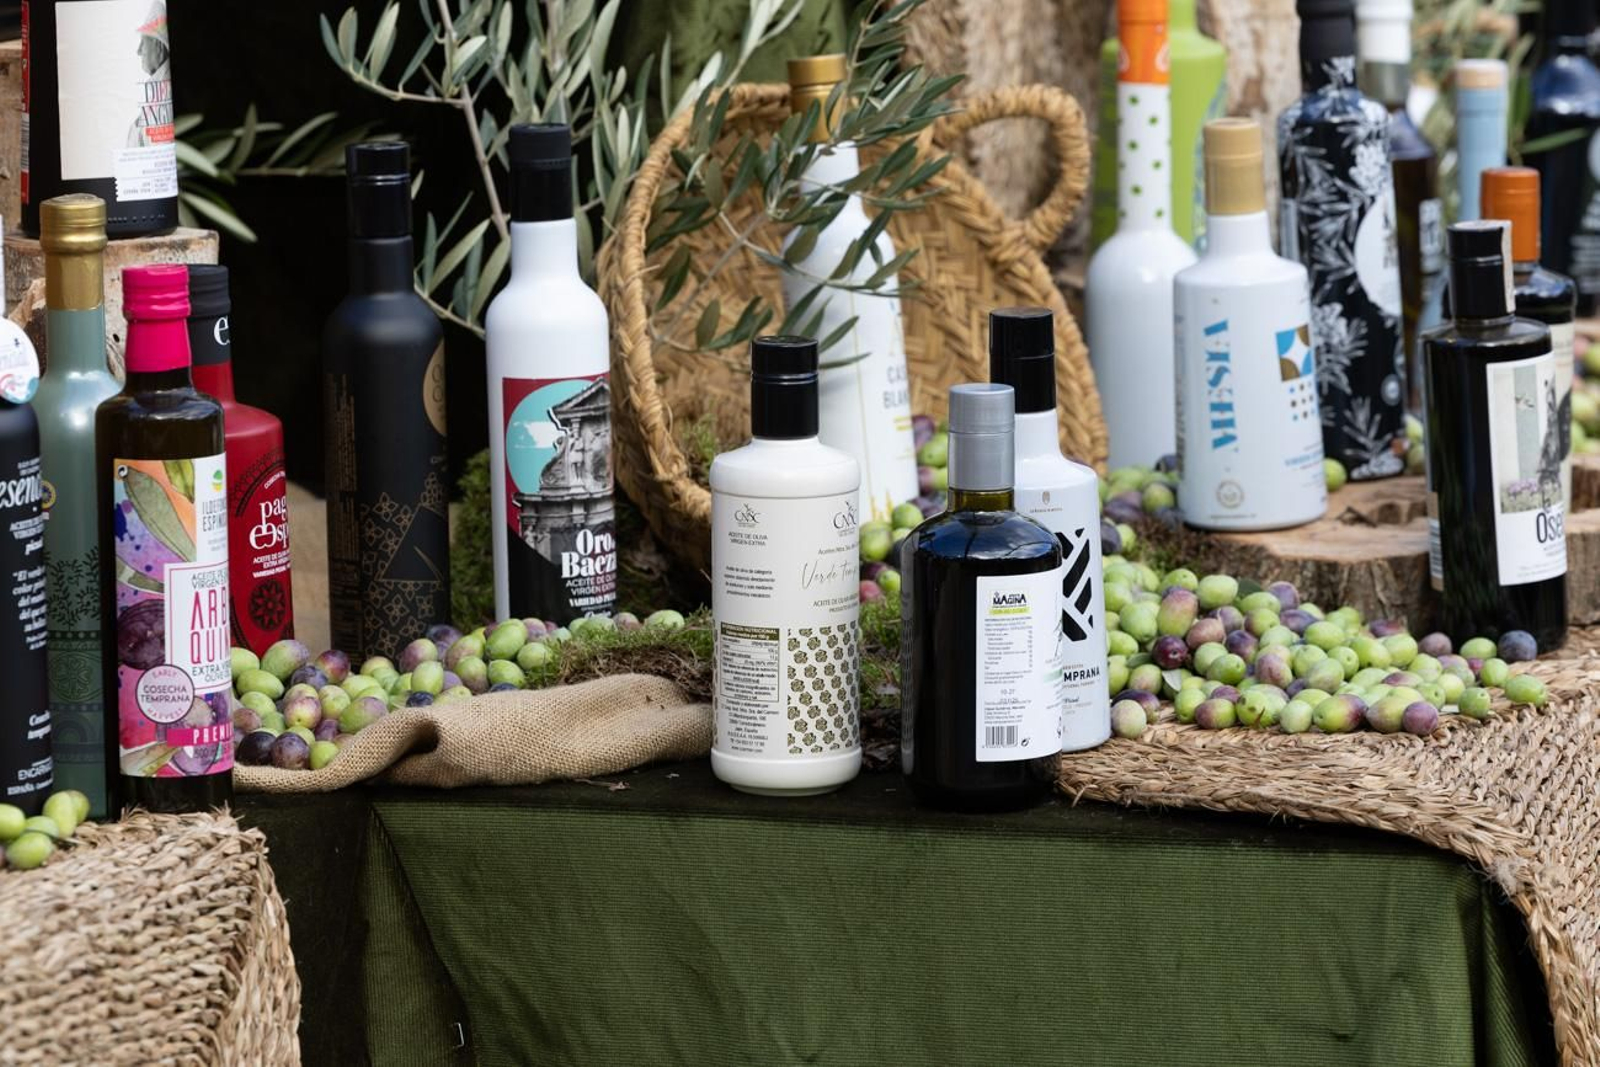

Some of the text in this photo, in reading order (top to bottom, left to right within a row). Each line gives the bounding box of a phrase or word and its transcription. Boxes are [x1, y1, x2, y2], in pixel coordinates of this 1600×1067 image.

[576, 529, 612, 556] Oro
[143, 684, 187, 694] COSECHA
[141, 694, 190, 703] TEMPRANA
